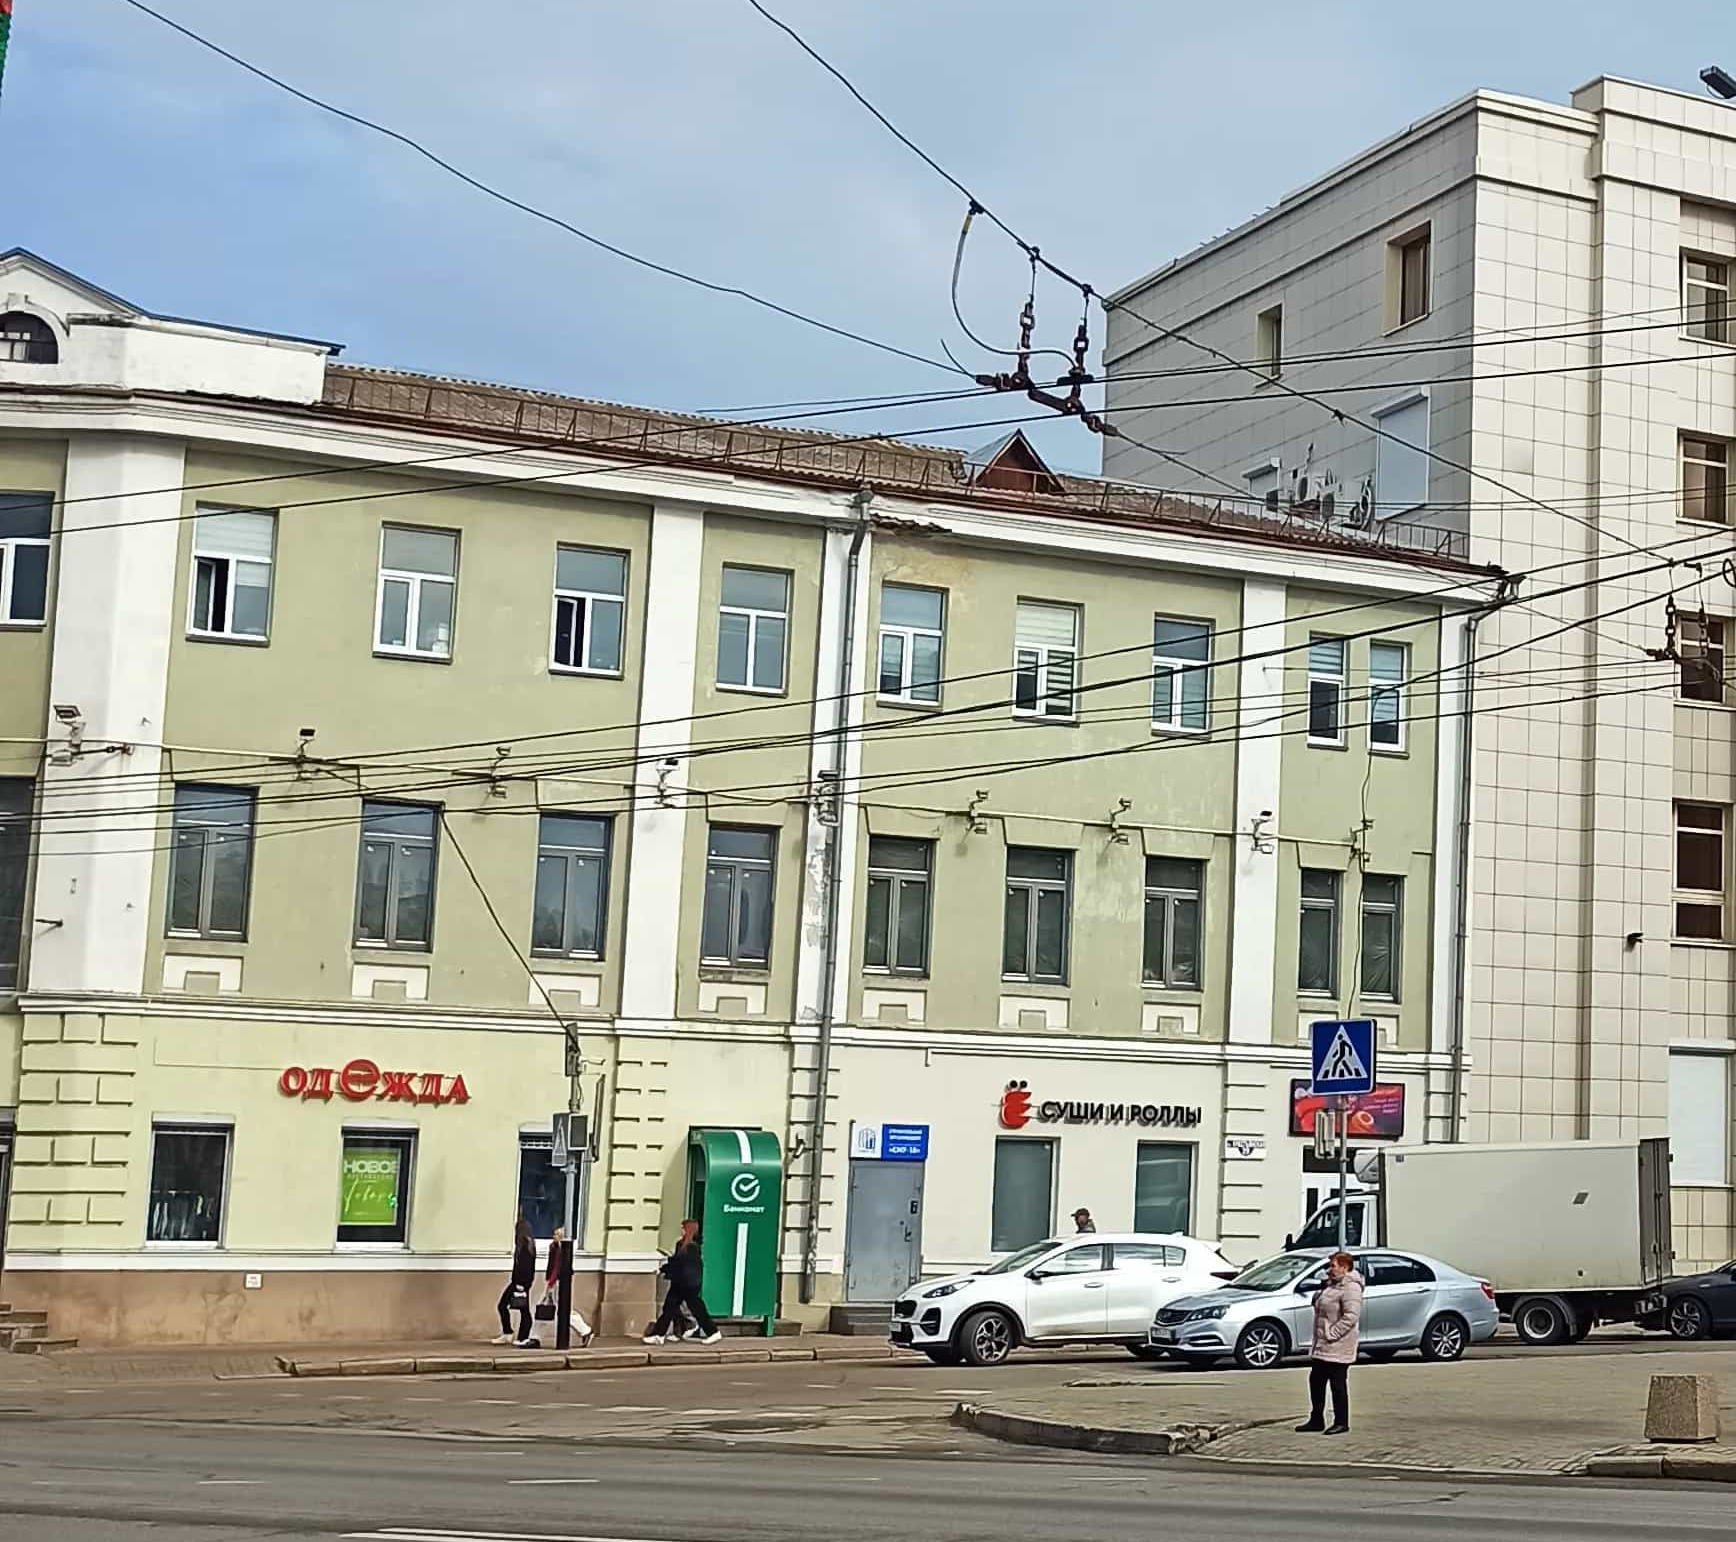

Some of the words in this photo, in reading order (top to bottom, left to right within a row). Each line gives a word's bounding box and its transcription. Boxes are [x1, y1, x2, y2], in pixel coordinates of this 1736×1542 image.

[1041, 1101, 1104, 1122] СУШИ
[1110, 1104, 1124, 1121] И
[1130, 1105, 1202, 1125] РОЛЛЫ
